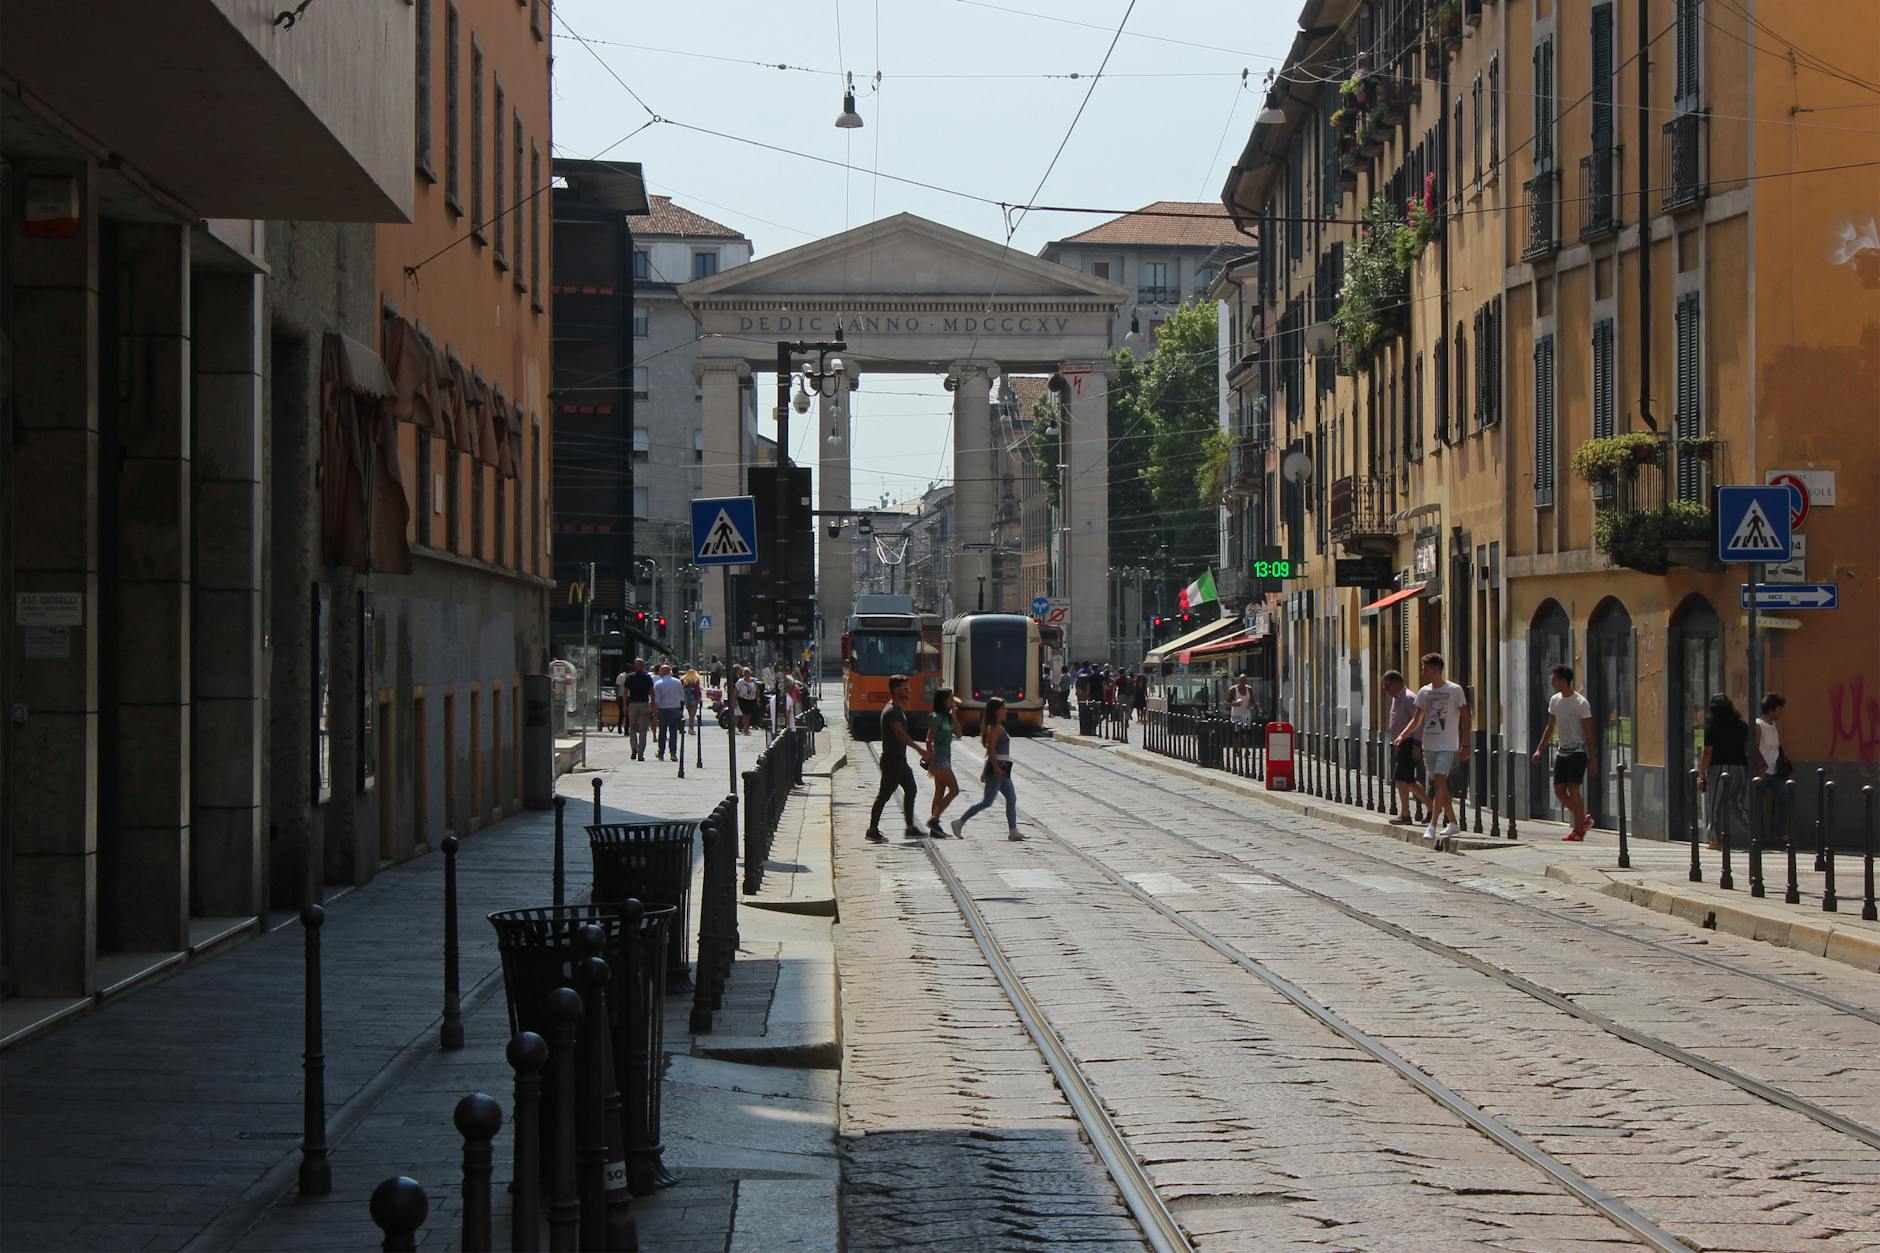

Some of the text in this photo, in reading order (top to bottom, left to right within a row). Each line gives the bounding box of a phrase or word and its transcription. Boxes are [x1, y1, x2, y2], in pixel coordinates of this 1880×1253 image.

[740, 316, 1068, 333] DEDIC ANNO MDCCCXV
[1253, 560, 1290, 578] 13:09
